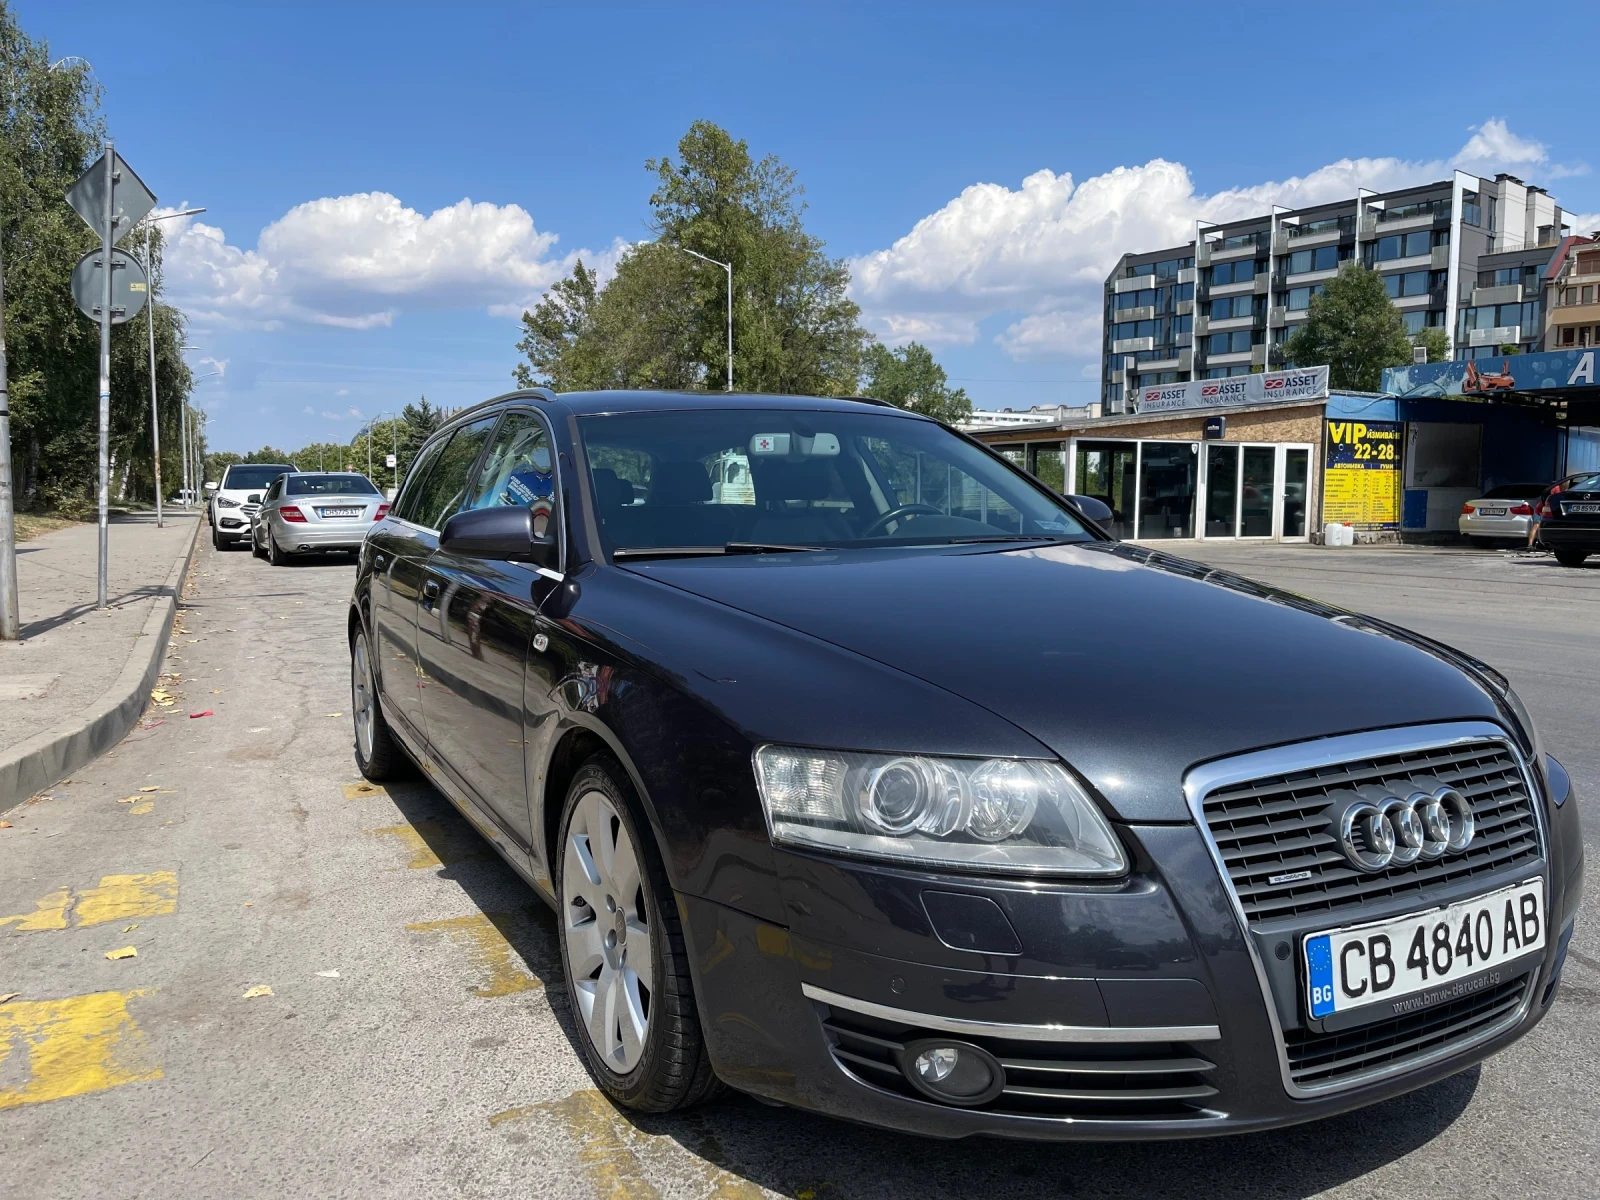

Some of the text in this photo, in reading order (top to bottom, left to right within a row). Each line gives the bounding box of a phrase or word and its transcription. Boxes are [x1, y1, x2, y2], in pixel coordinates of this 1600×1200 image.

[1285, 375, 1318, 388] ASSET
[1161, 389, 1186, 400] ASSET
[1219, 383, 1246, 394] ASSET
[1264, 386, 1317, 399] INSURANCE
[1144, 399, 1186, 409] INSURANCE
[1201, 393, 1246, 404] INSURANCE
[1329, 422, 1367, 444] VIP
[1340, 892, 1540, 998] CB 4840 AB
[1312, 984, 1332, 1005] BG
[1392, 971, 1500, 1014] www.bmw-darucar.bg
